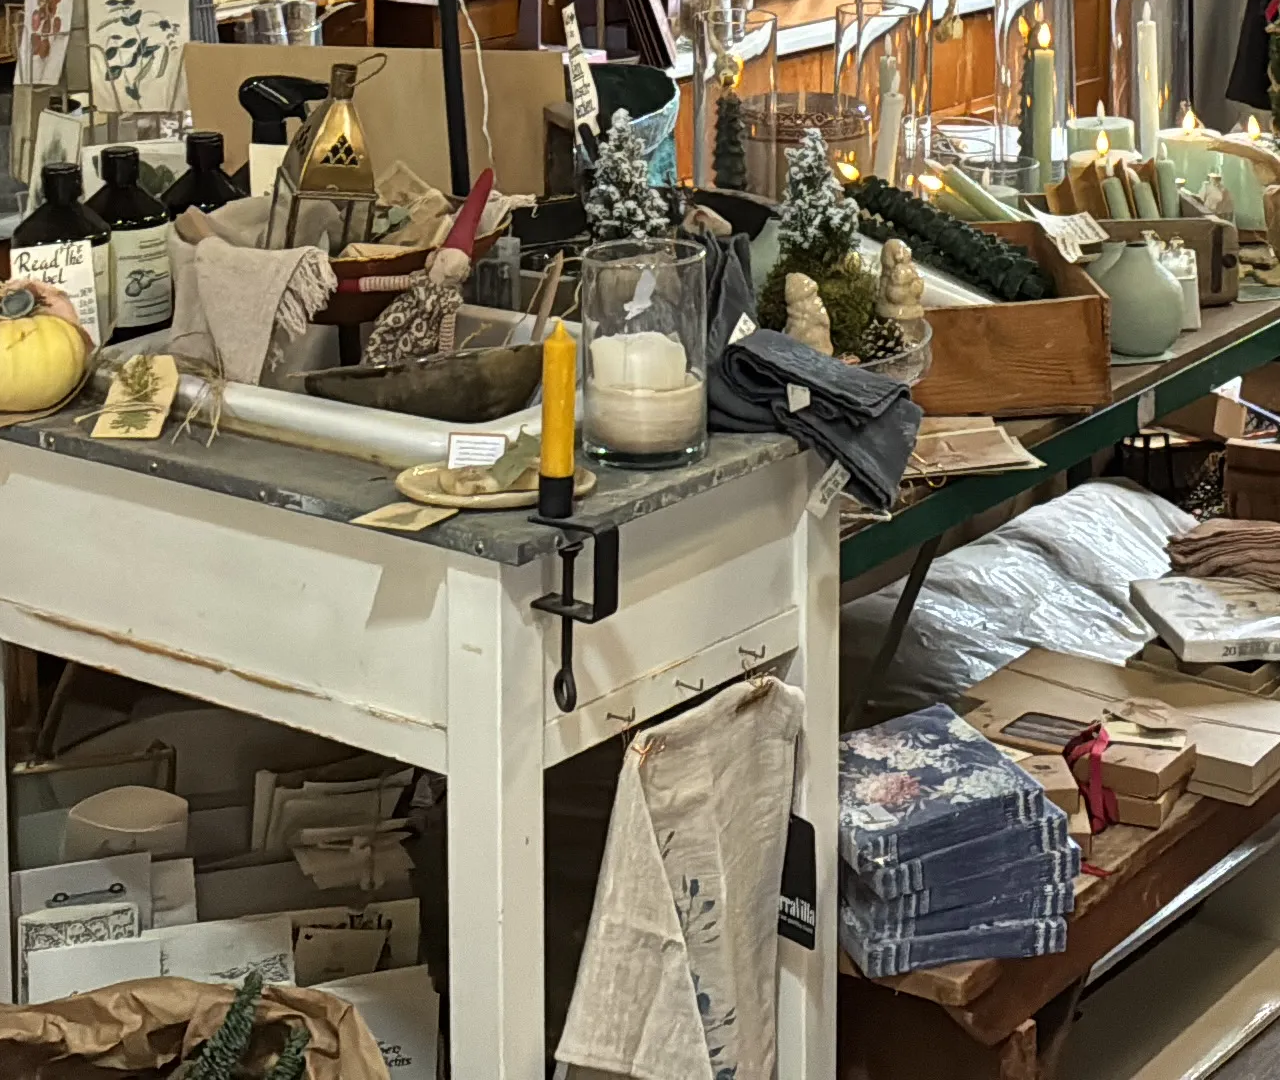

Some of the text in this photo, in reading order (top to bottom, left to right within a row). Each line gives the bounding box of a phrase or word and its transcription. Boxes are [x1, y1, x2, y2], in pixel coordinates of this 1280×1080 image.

[14, 248, 60, 273] Read
[1222, 645, 1237, 657] 20
[780, 895, 815, 927] rraVilla
